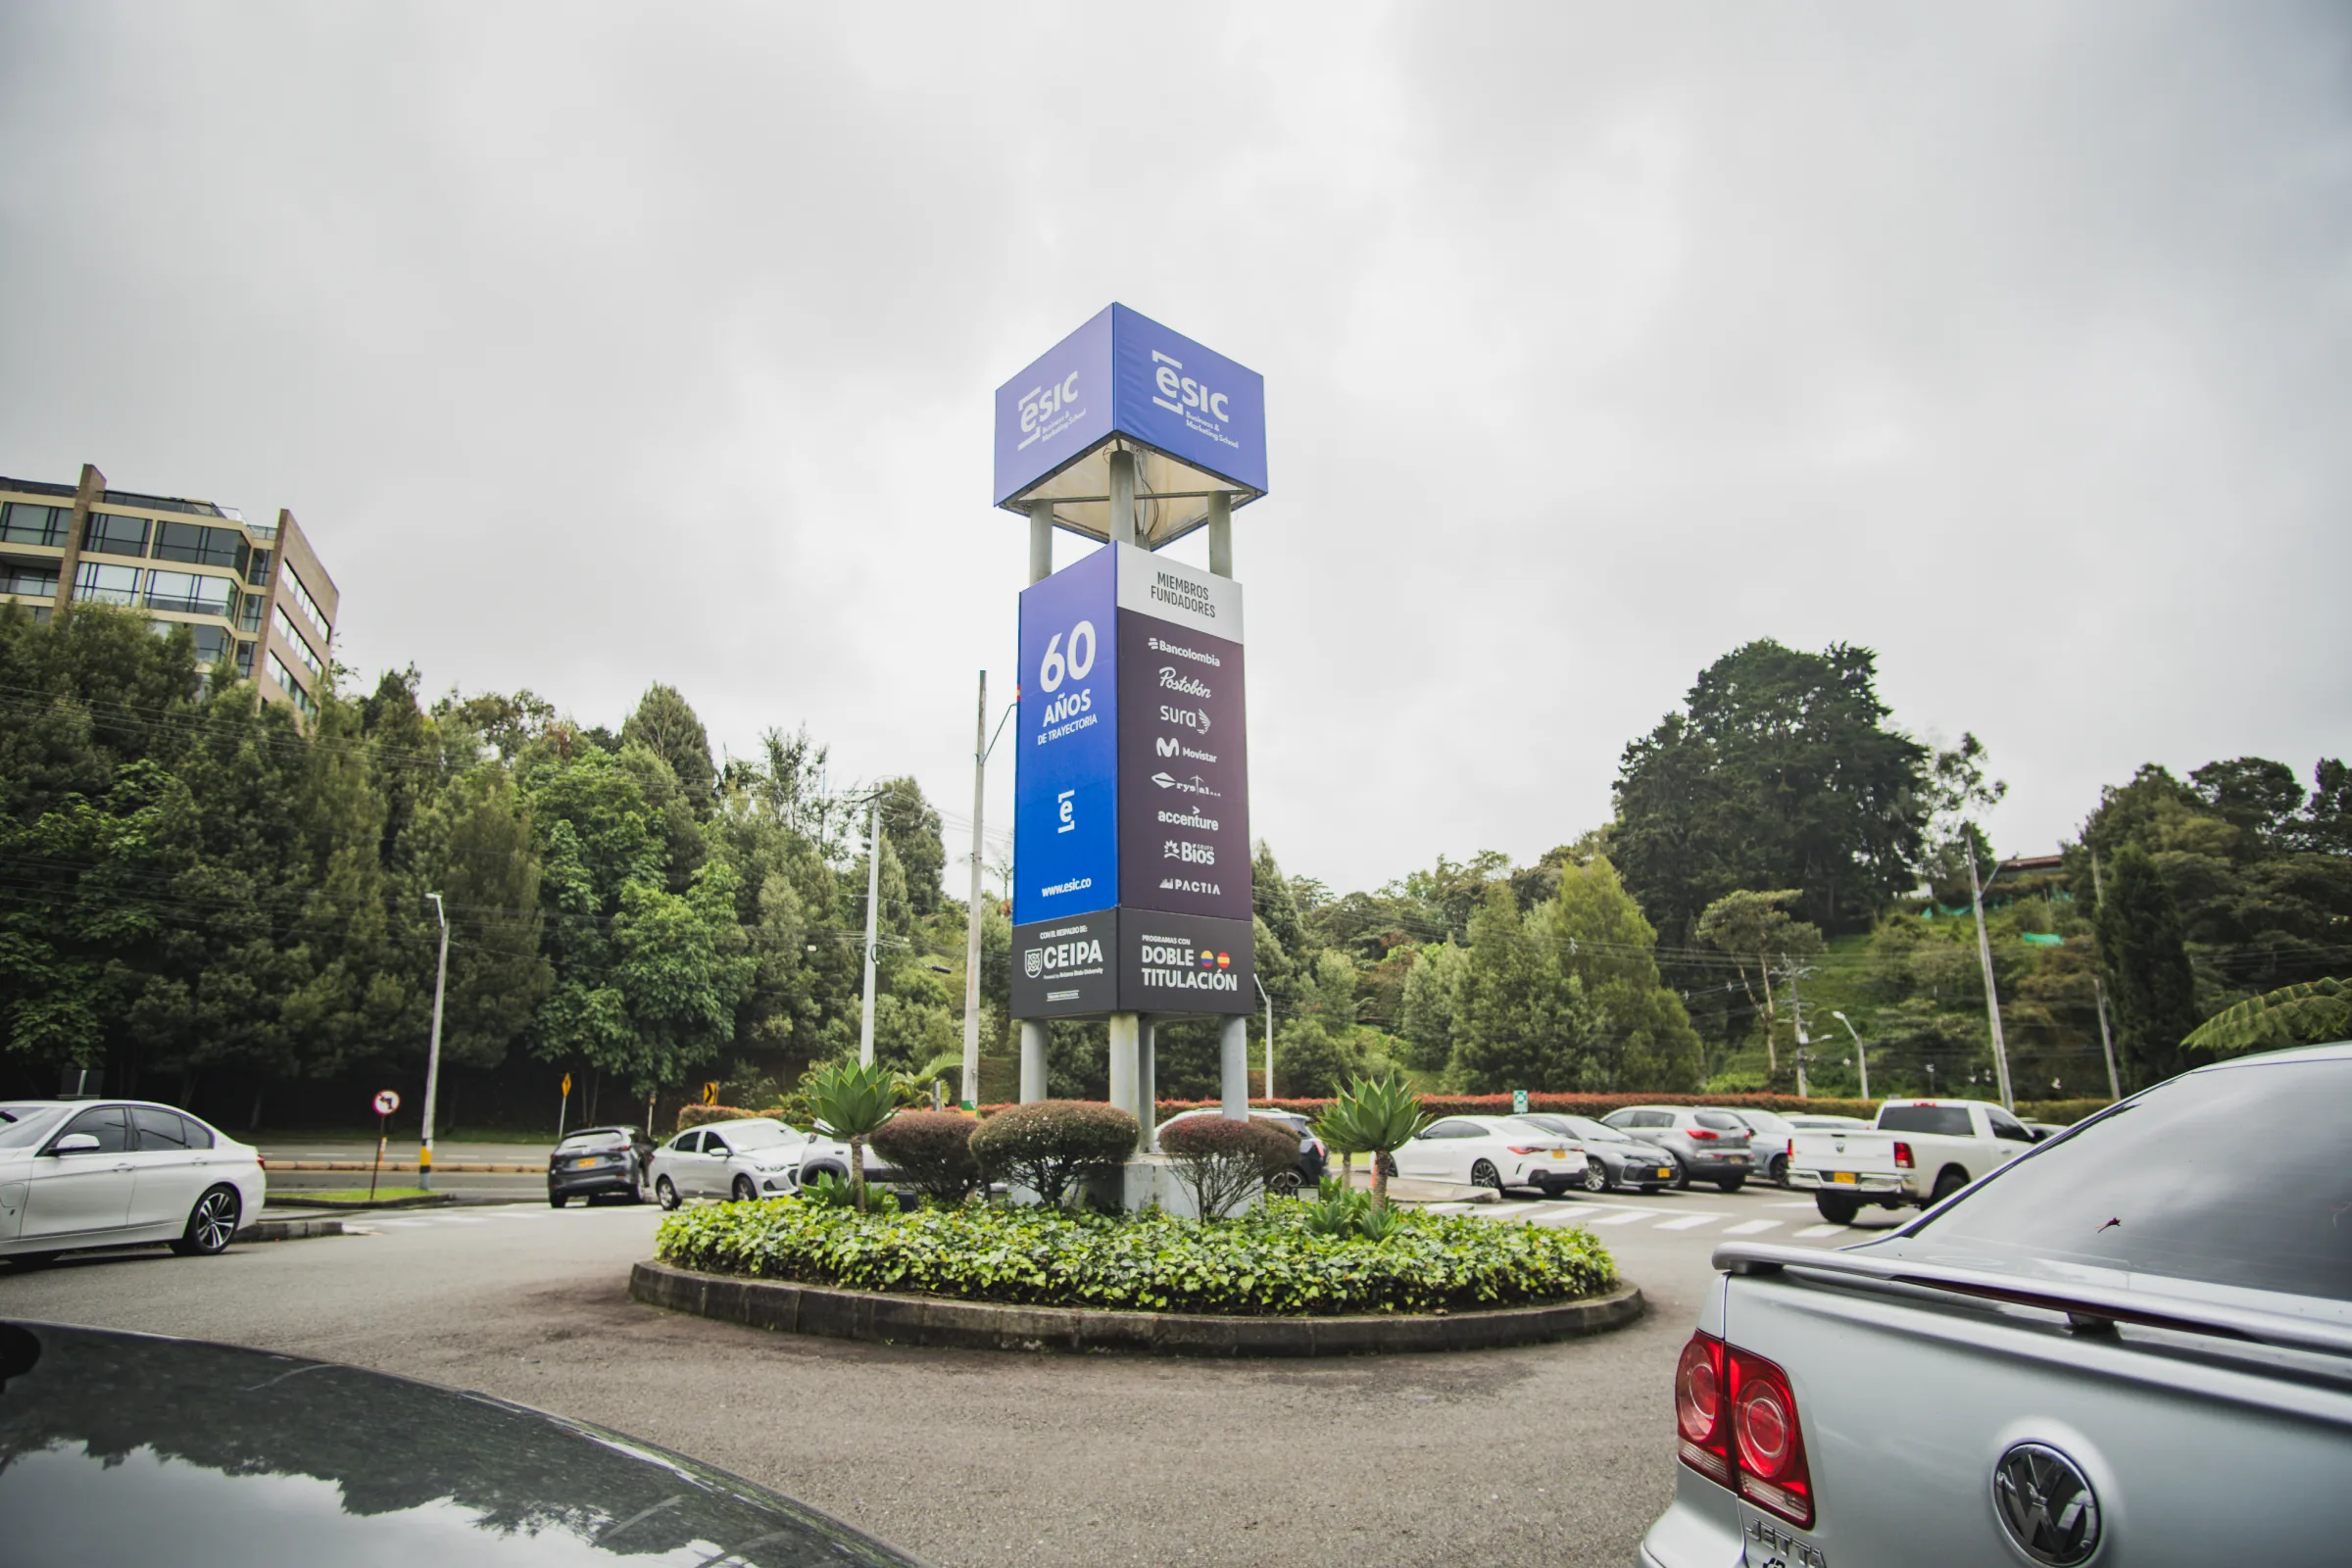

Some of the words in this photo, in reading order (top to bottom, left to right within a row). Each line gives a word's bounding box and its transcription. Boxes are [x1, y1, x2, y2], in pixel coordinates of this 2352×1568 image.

[1020, 370, 1079, 434] esic
[1154, 364, 1230, 423] esic
[1186, 411, 1213, 429] Business
[1186, 419, 1218, 441] Marketing
[1219, 434, 1239, 449] School
[1157, 571, 1208, 601] MIEMBROS
[1151, 585, 1216, 618] FUNDADORES
[1040, 620, 1097, 693] 60
[1159, 640, 1221, 667] Bancolombia
[1158, 666, 1211, 699] Postobón
[1042, 688, 1092, 727] AÑOS
[1159, 705, 1197, 728] sura
[1037, 732, 1048, 746] DE
[1048, 712, 1098, 742] TRAYECTORIA
[1182, 747, 1217, 763] Movistar
[1157, 808, 1219, 831] accenture
[1041, 878, 1092, 898] www.esic.co
[1174, 878, 1221, 896] PACTIA
[1055, 926, 1080, 937] RESPALDO
[1142, 934, 1177, 944] PROGRAMAS
[1043, 939, 1103, 969] CEIPA
[1142, 945, 1195, 966] DOBLE
[1141, 968, 1238, 992] TITULACIÓN
[1745, 1517, 1828, 1568] JETTA
